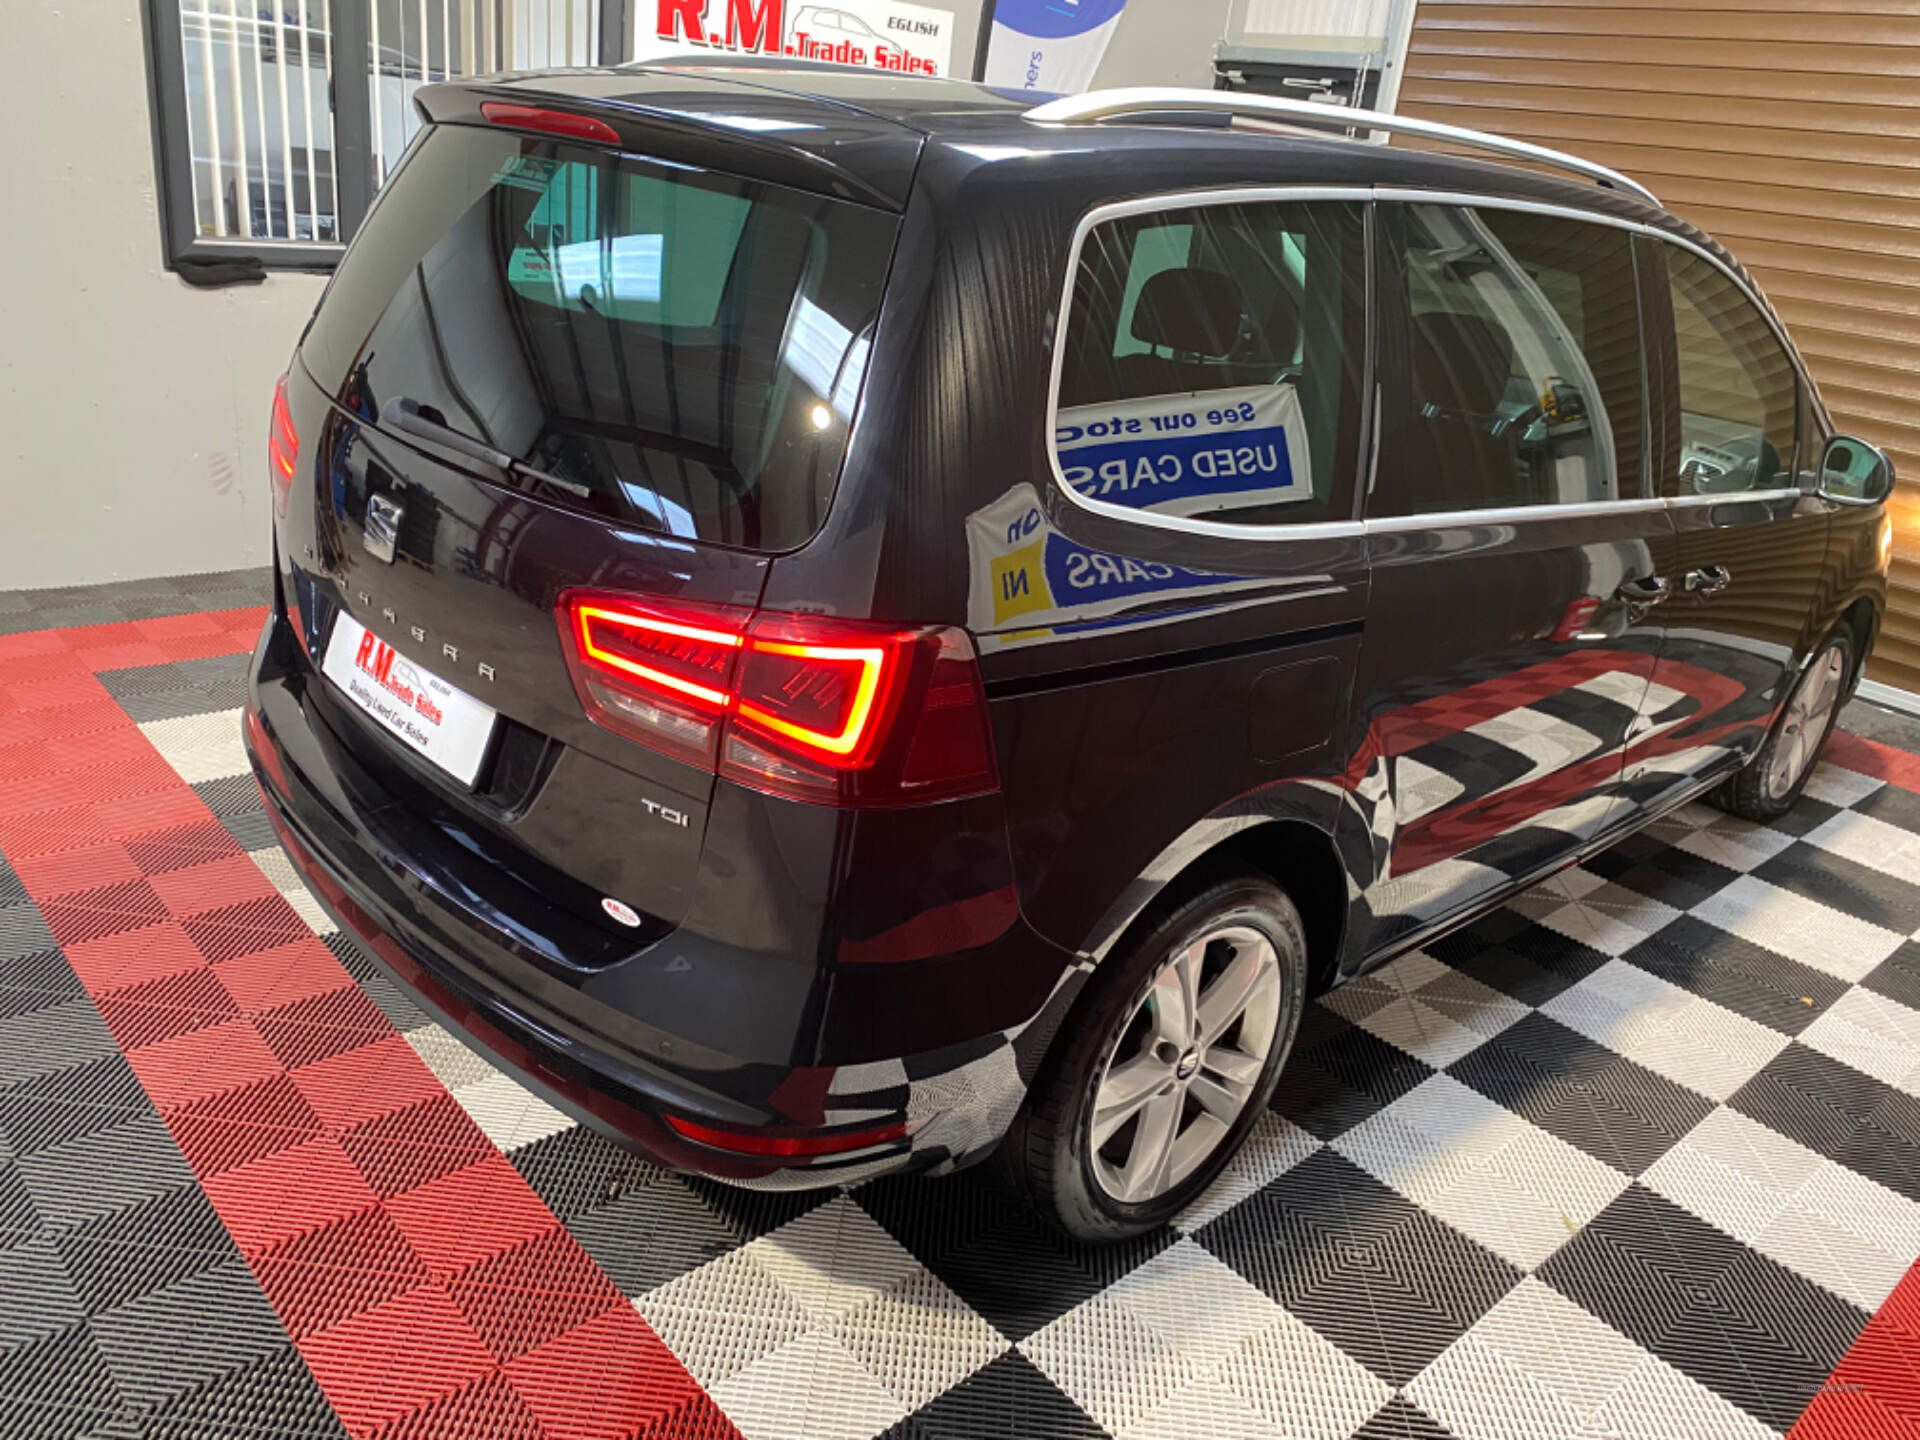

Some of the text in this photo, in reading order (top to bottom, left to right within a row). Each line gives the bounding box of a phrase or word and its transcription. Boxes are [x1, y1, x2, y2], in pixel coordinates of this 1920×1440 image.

[886, 16, 940, 37] EGLISH
[795, 31, 867, 66] Trade
[874, 45, 938, 76] Sales
[349, 679, 374, 708] Quality
[391, 711, 406, 728] Car
[405, 723, 428, 746] Sales
[415, 693, 443, 726] Sales
[641, 797, 689, 827] TDI
